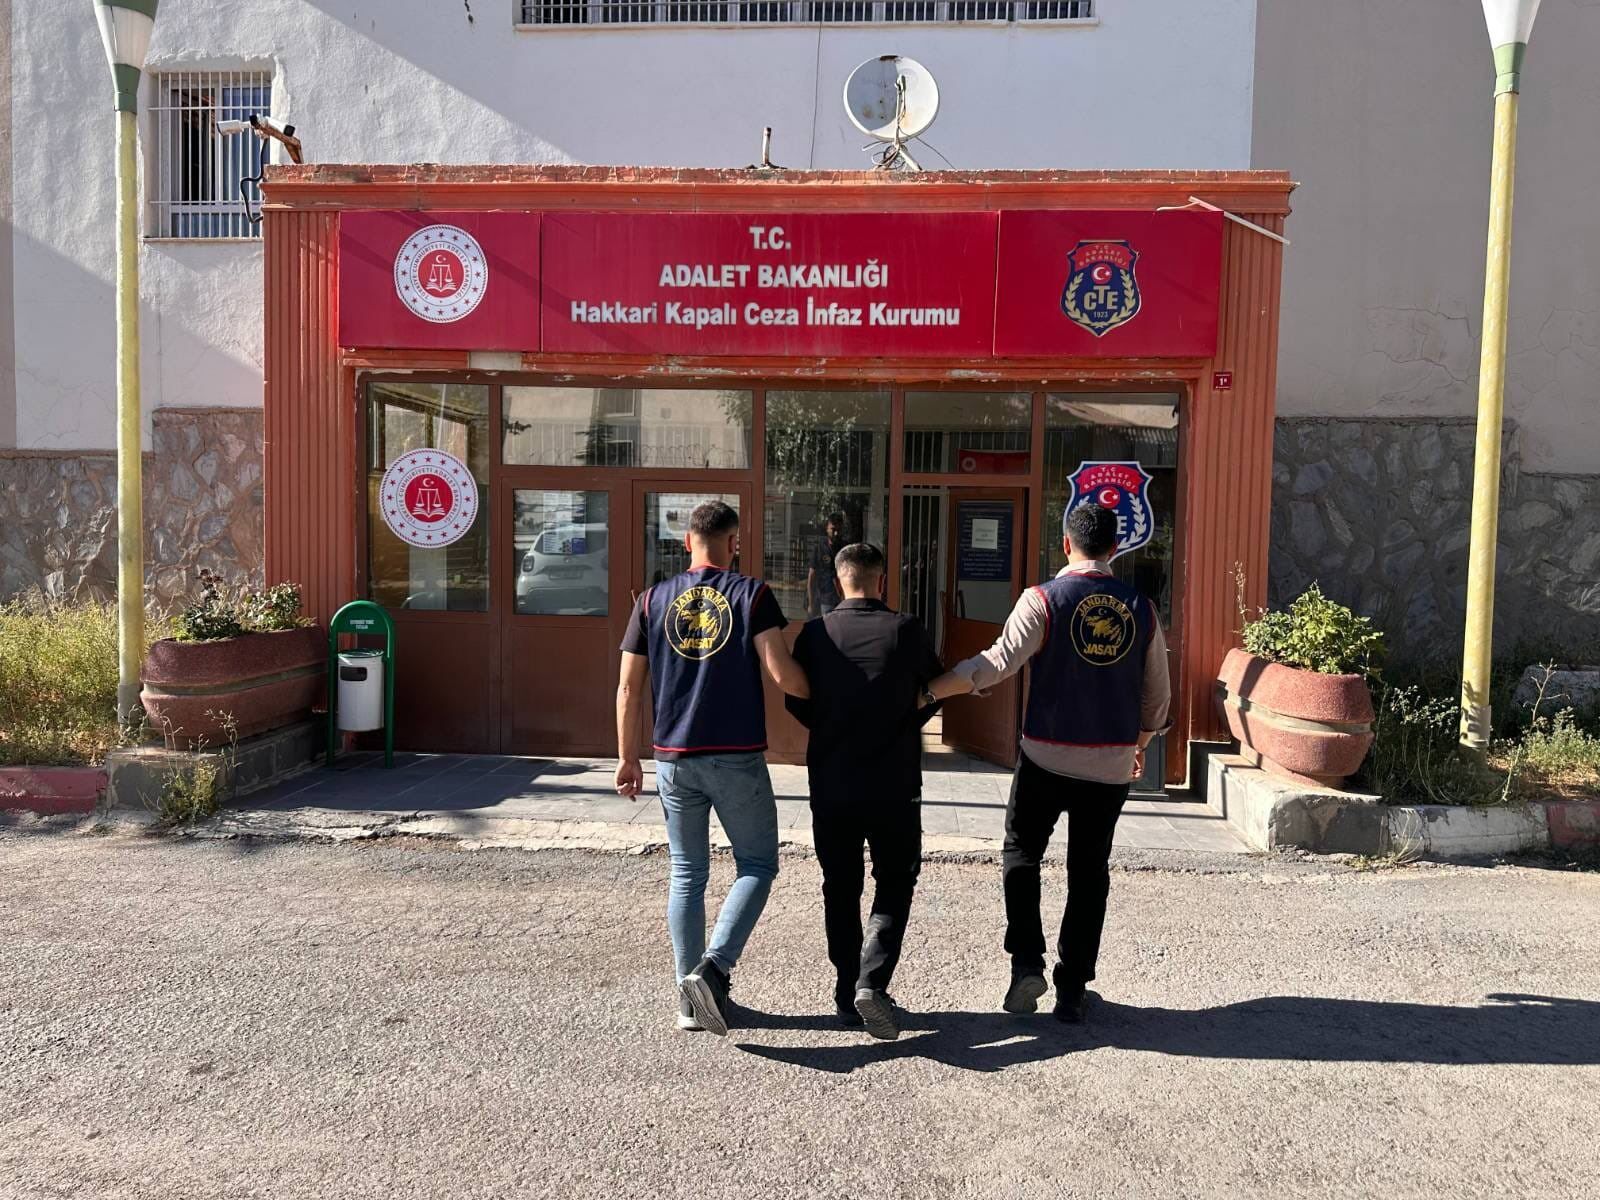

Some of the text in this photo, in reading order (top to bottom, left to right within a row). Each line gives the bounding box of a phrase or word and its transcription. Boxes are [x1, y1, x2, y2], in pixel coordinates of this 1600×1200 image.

[749, 227, 792, 250] T.C.
[659, 259, 888, 288] ADALET BAKANLIĞI
[1083, 285, 1118, 310] CTE
[571, 296, 960, 330] Hakkari Kapalı Ceza İnfaz Kurumu
[675, 588, 728, 612] JANDARMA
[1079, 597, 1131, 620] JANDARMA
[679, 638, 714, 649] JASAT
[1083, 643, 1120, 656] JASAT
